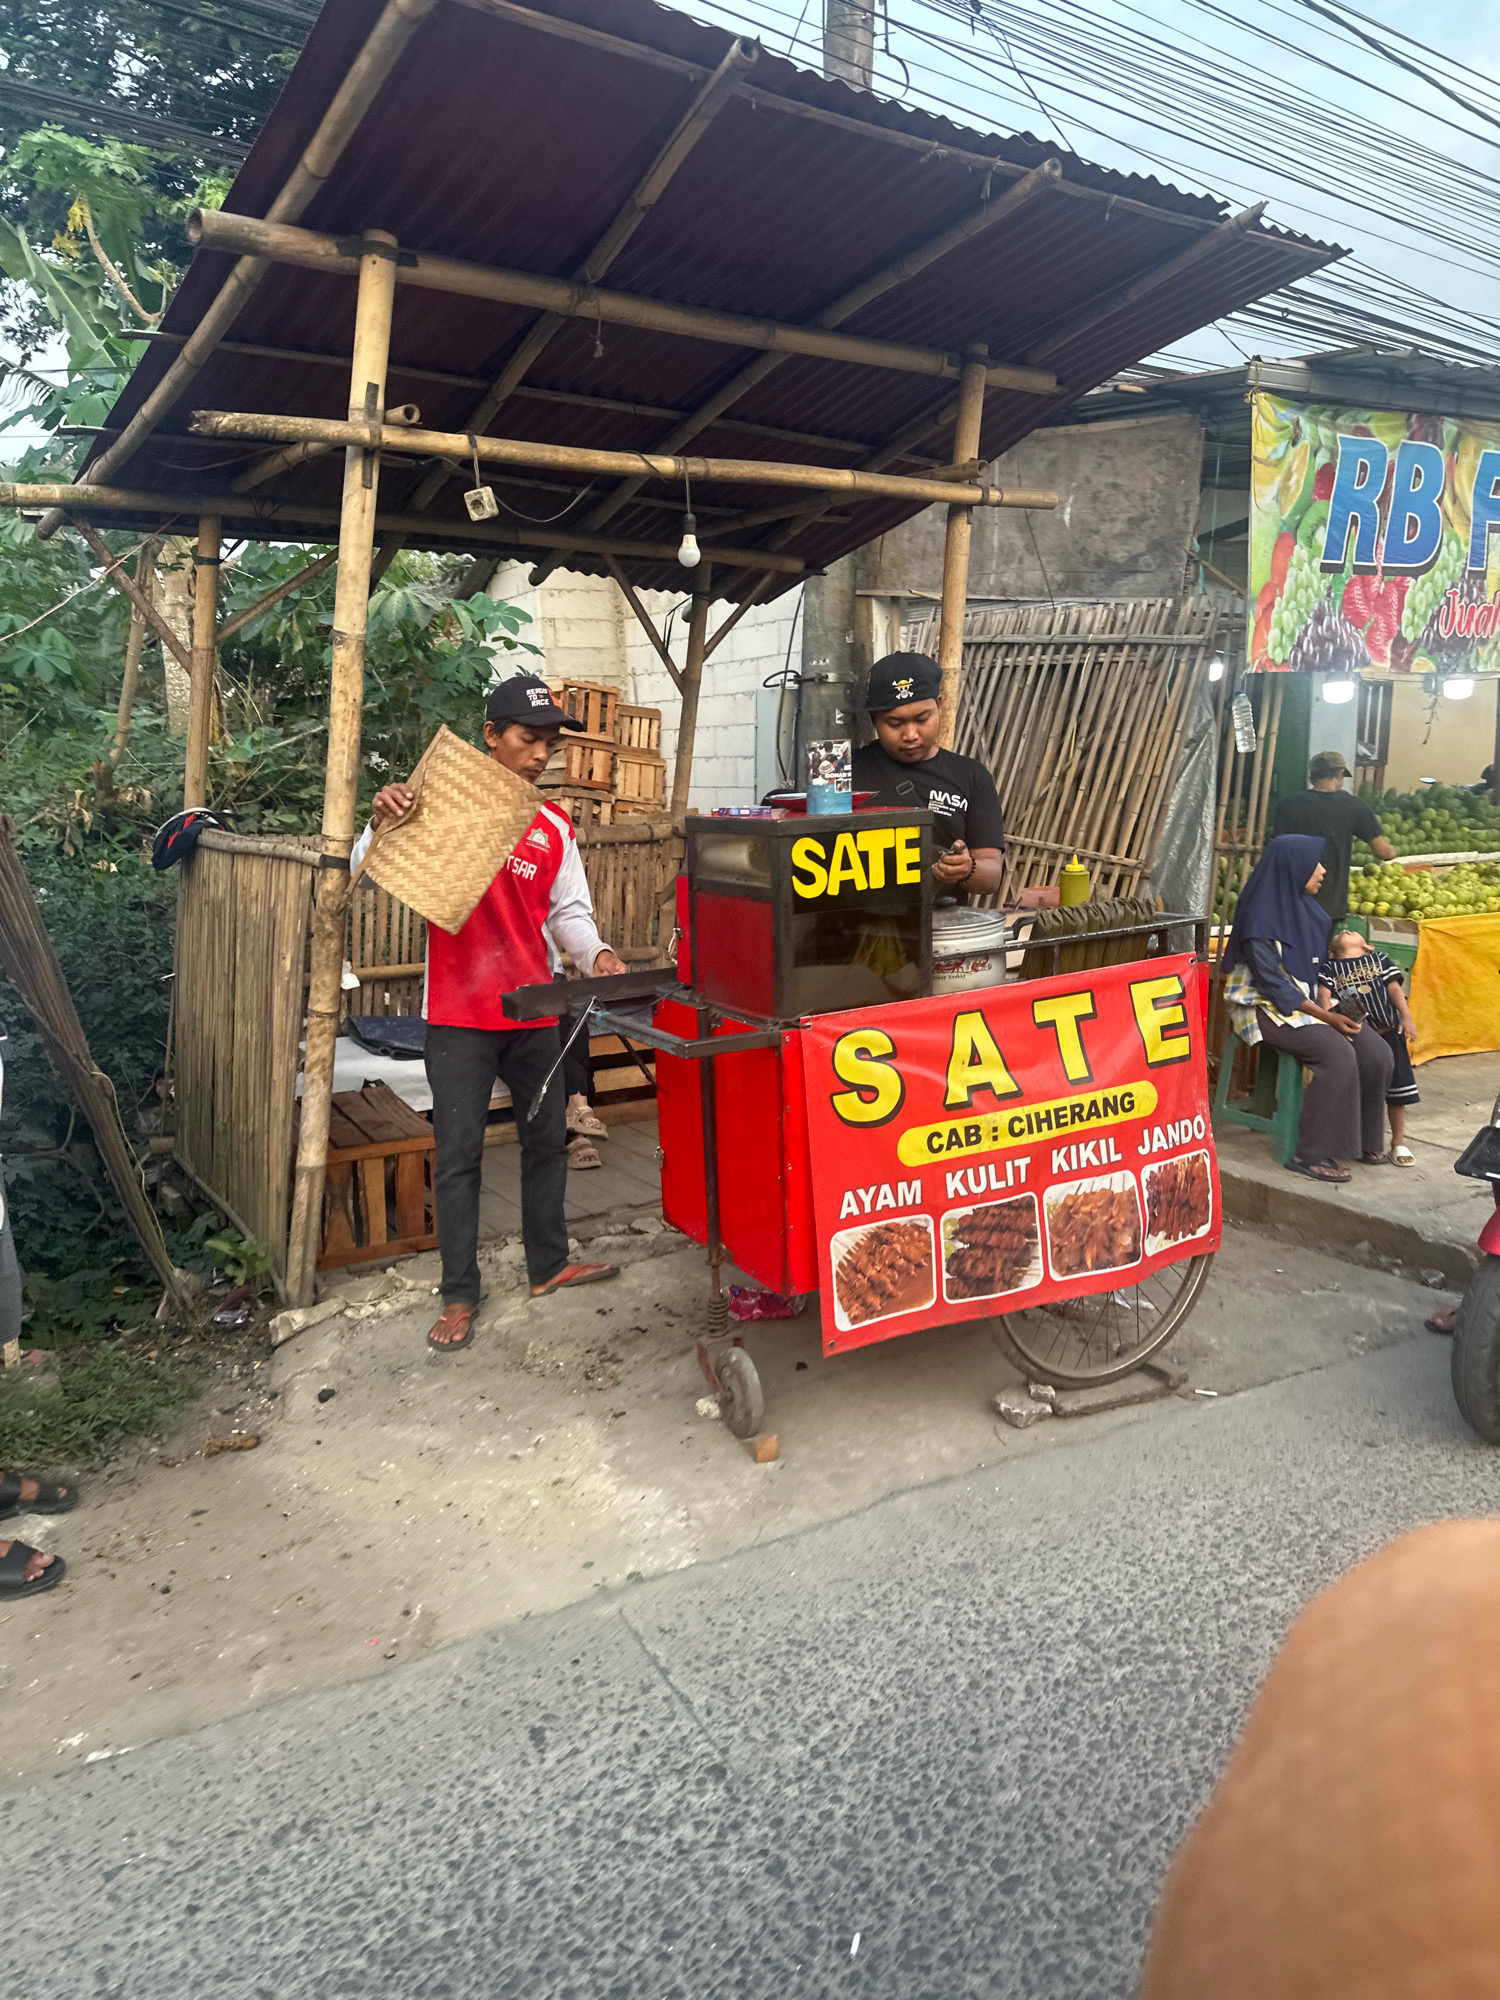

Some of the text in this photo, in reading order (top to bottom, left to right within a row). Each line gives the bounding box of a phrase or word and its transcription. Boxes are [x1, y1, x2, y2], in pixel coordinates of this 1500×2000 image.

[1320, 434, 1445, 574] RB
[526, 687, 548, 696] READY
[531, 698, 550, 707] RACE
[929, 789, 969, 812] NASA
[791, 826, 921, 899] SATE
[830, 974, 1192, 1129] SATE
[926, 1124, 983, 1154] CAB
[1008, 1091, 1136, 1139] CIHERANG
[839, 1115, 1206, 1221] AYAM KULIT KIKIL JANDO
